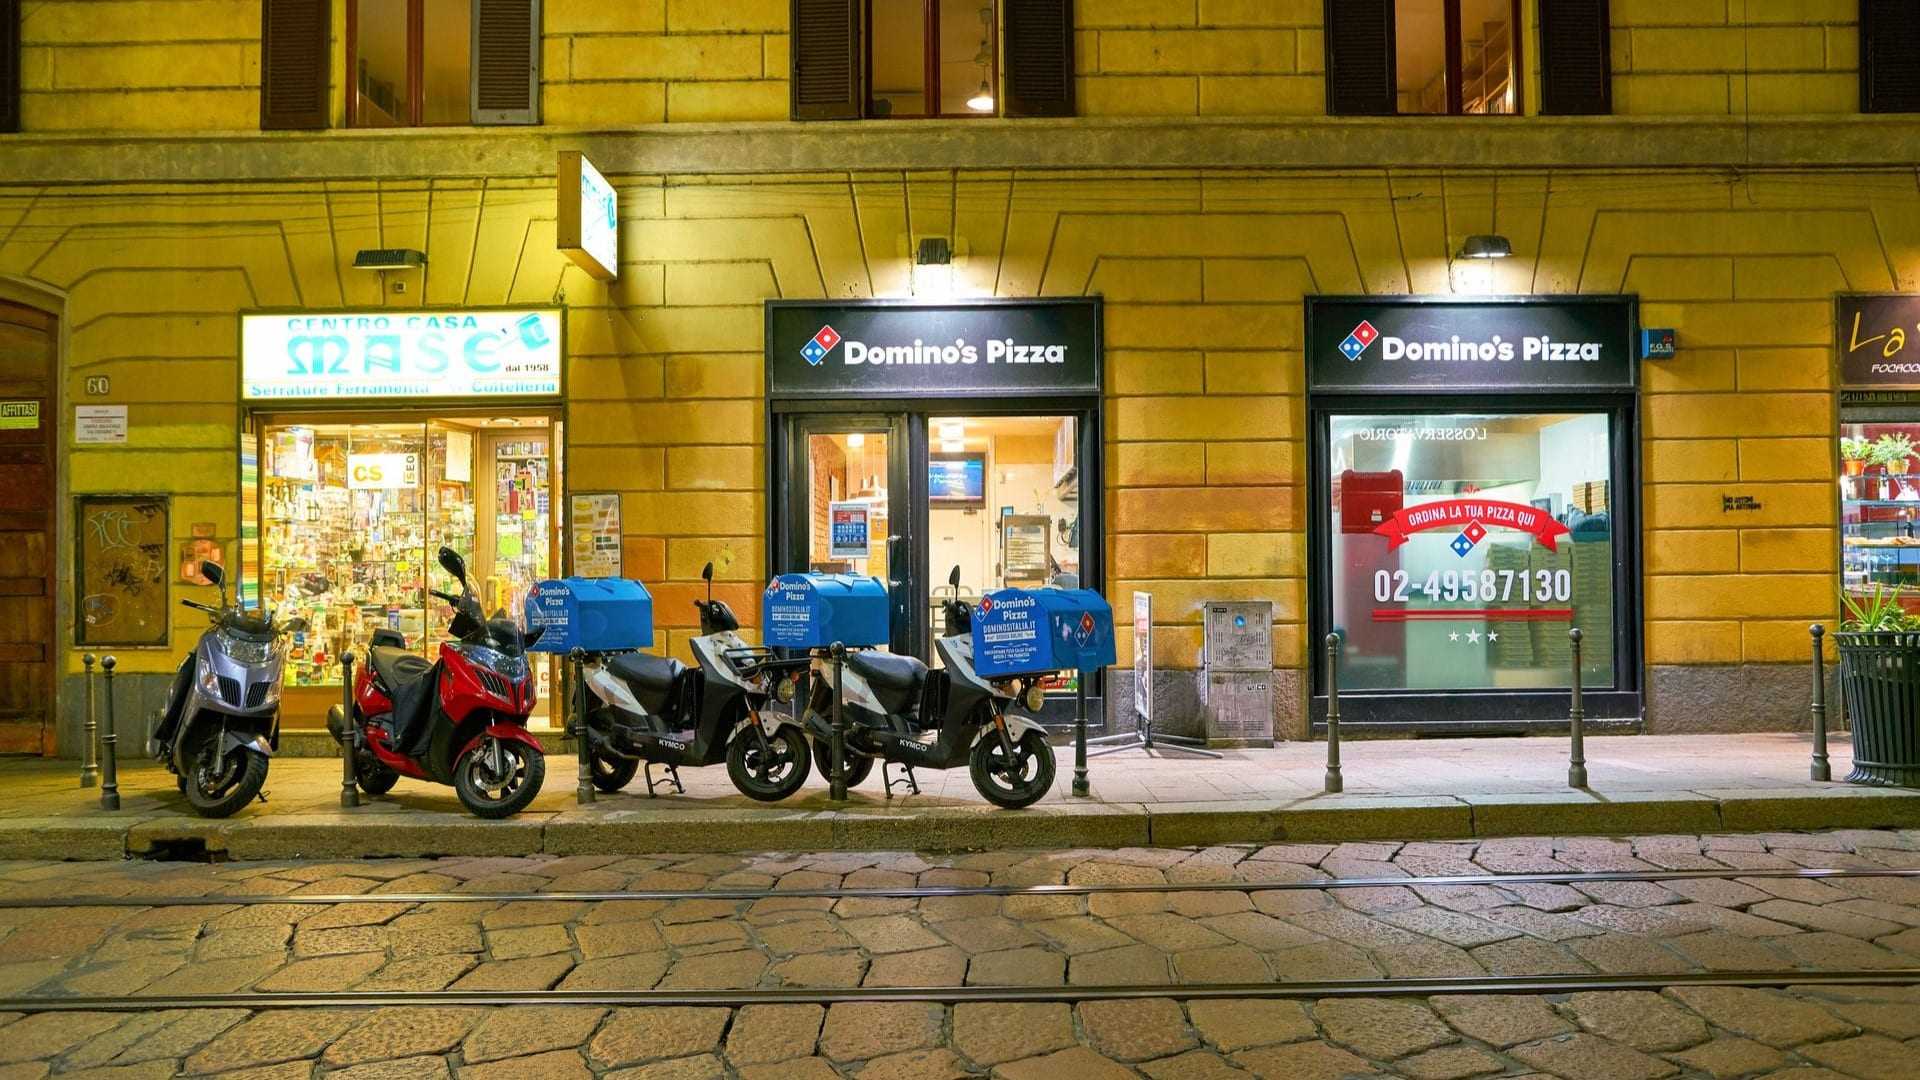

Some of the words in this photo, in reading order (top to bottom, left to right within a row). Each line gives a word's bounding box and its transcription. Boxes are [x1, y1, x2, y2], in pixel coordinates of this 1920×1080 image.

[287, 317, 390, 331] CENTRO
[406, 315, 478, 329] CASA
[1849, 311, 1905, 357] La
[844, 338, 978, 365] Domino's
[986, 338, 1065, 365] Pizza
[1382, 335, 1514, 361] Domino's
[1522, 335, 1600, 361] Pizza
[505, 363, 521, 372] dal
[525, 363, 550, 372] 1958
[1871, 363, 1920, 374] FOCACC
[87, 377, 110, 394] 60
[251, 386, 329, 397] Serrature
[2, 403, 37, 417] AFFITTASI
[1408, 507, 1448, 527] ORDINA
[1449, 506, 1462, 519] LA
[1465, 505, 1484, 518] TUA
[1486, 506, 1516, 521] PIZZA
[1517, 511, 1537, 527] QUI
[539, 586, 570, 597] Domino's
[780, 581, 811, 591] Domino's
[1374, 569, 1571, 602] 02-49587130
[545, 598, 564, 606] Pizza
[785, 591, 805, 601] Pizza
[993, 596, 1036, 610] Domino's
[1002, 610, 1028, 621] Pizza
[983, 620, 1036, 634] DOMINOSITALIA.IT
[658, 737, 685, 750] KYMCO
[900, 738, 928, 752] KYMCO
